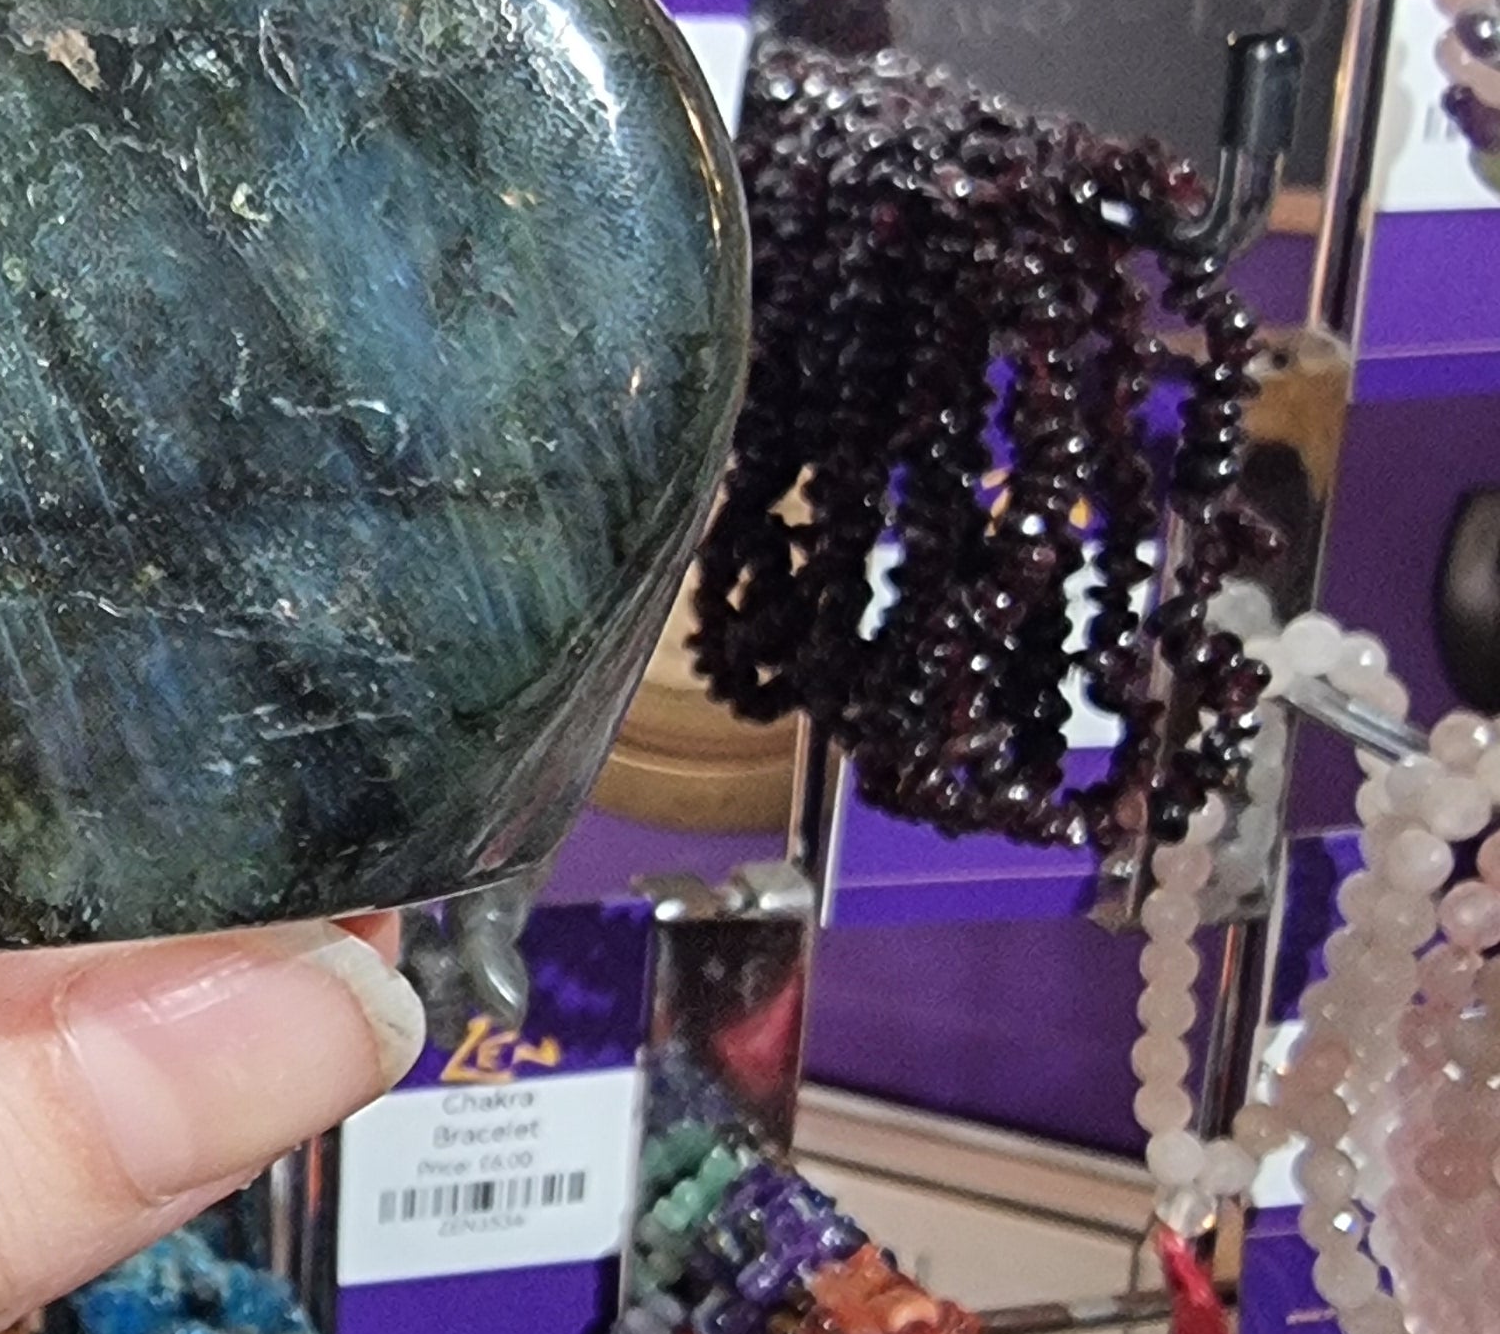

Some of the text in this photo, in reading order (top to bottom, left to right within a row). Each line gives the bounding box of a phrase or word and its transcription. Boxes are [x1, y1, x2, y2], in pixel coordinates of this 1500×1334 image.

[440, 1014, 561, 1084] ZEN
[442, 1090, 535, 1116] Chakra
[432, 1119, 540, 1150] Bracelet
[417, 1158, 468, 1179] Price:
